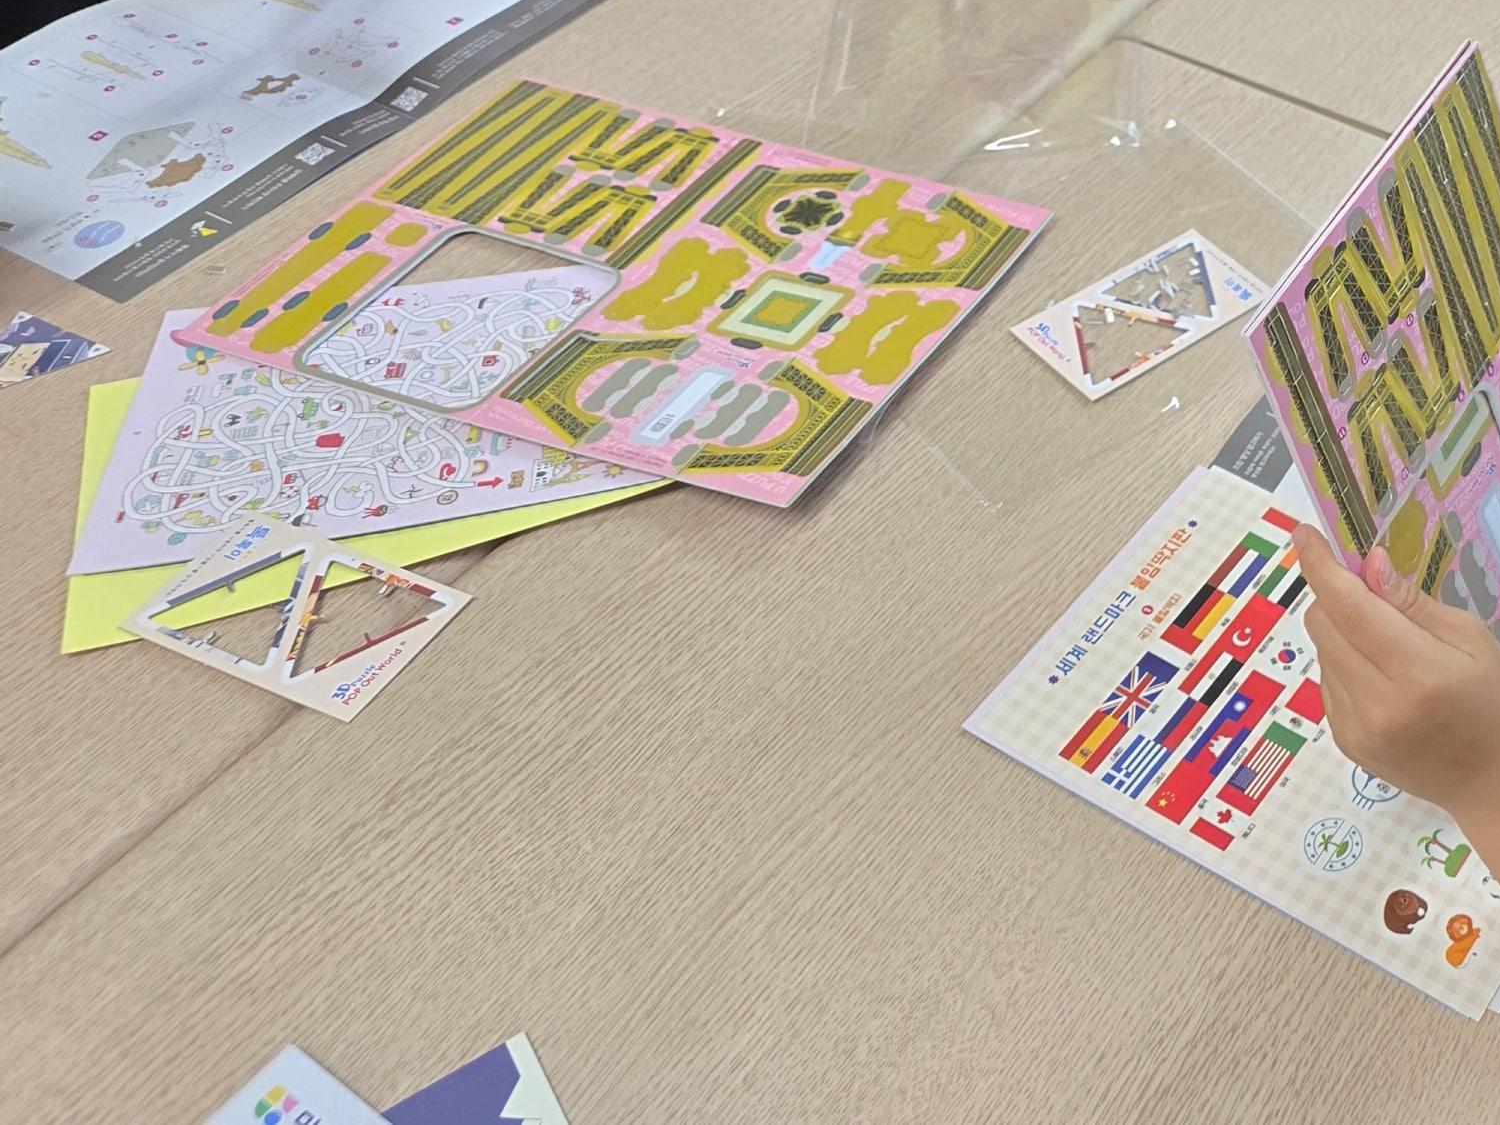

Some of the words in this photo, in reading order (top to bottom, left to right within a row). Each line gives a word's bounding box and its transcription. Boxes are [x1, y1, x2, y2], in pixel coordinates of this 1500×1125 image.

[1055, 644, 1088, 675] 세계
[1081, 590, 1136, 644] 랜드마크
[1130, 527, 1192, 591] 붙임딱지판
[331, 683, 351, 700] 3D
[342, 687, 361, 705] POP
[360, 672, 379, 687] Out
[375, 648, 402, 671] World
